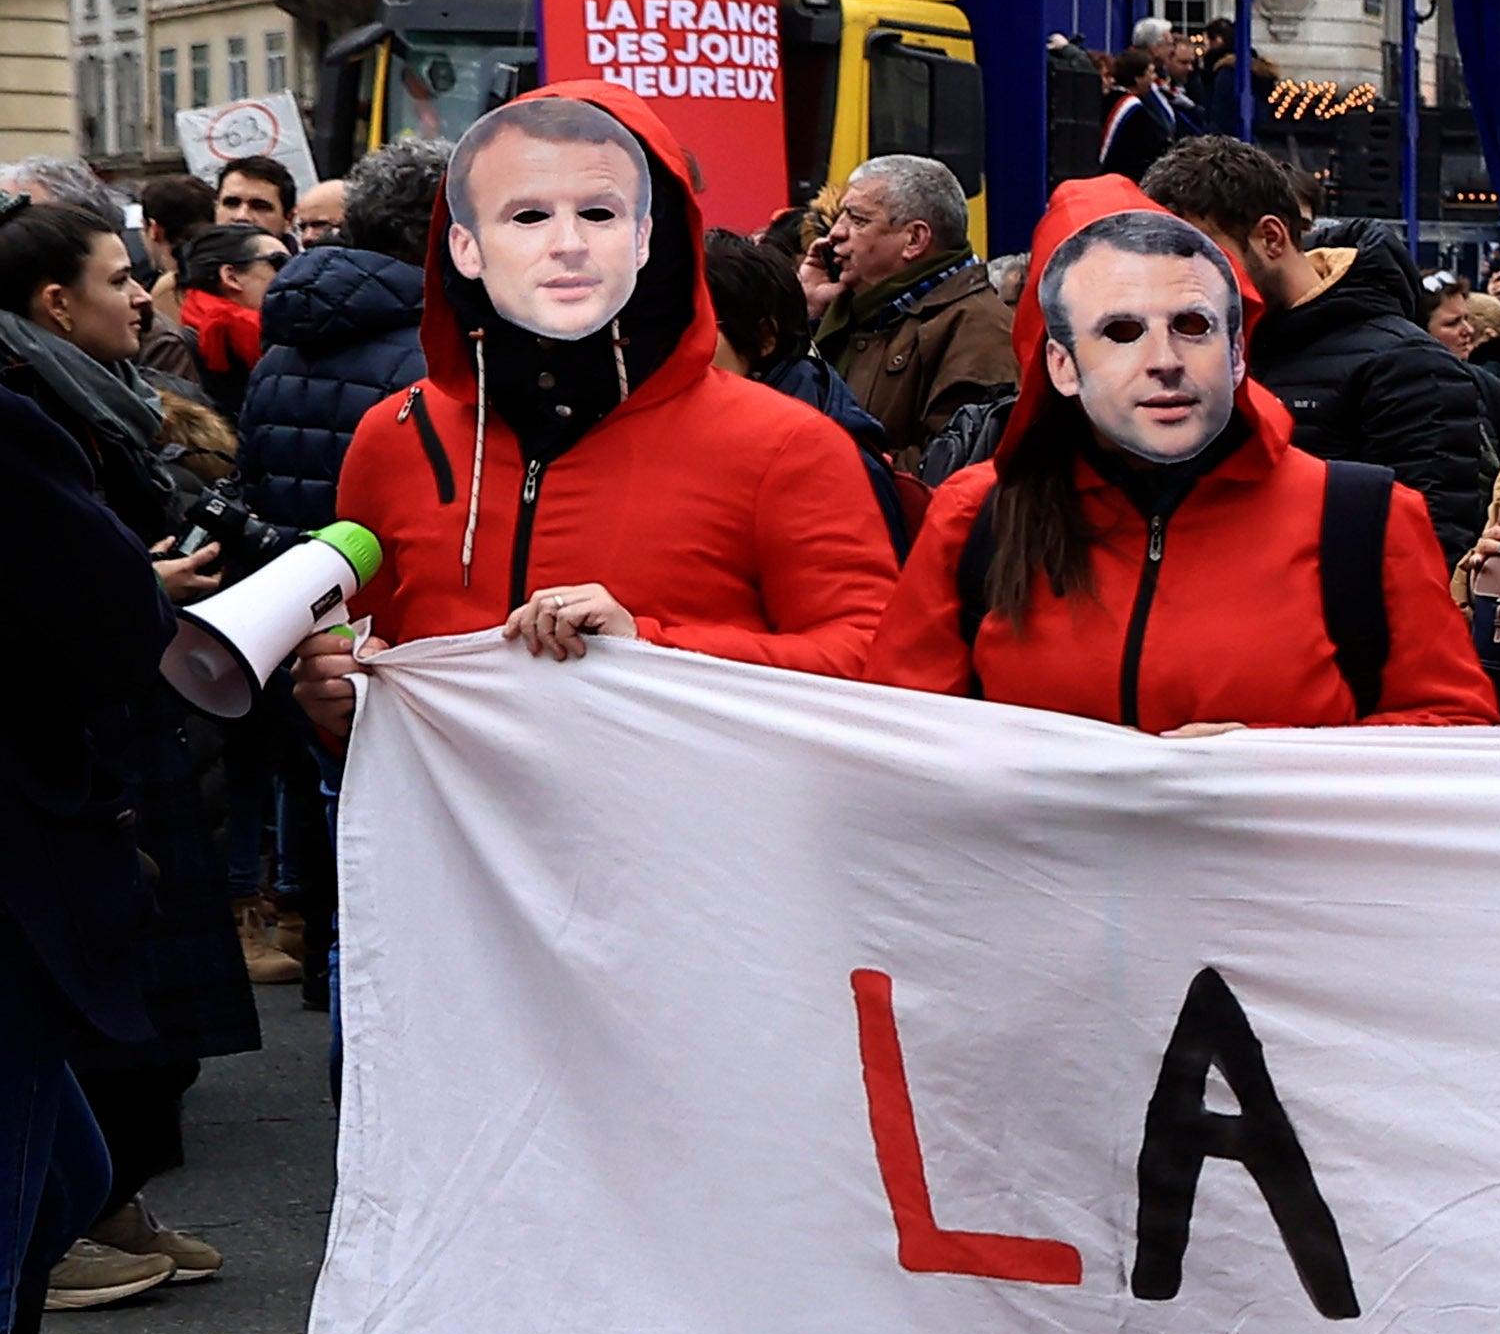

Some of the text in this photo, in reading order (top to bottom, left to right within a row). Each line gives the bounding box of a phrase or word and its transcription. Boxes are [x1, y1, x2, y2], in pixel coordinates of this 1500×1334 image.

[588, 32, 780, 69] DES JOURS
[602, 66, 777, 102] HEUREUX
[850, 966, 1361, 1320] LA
